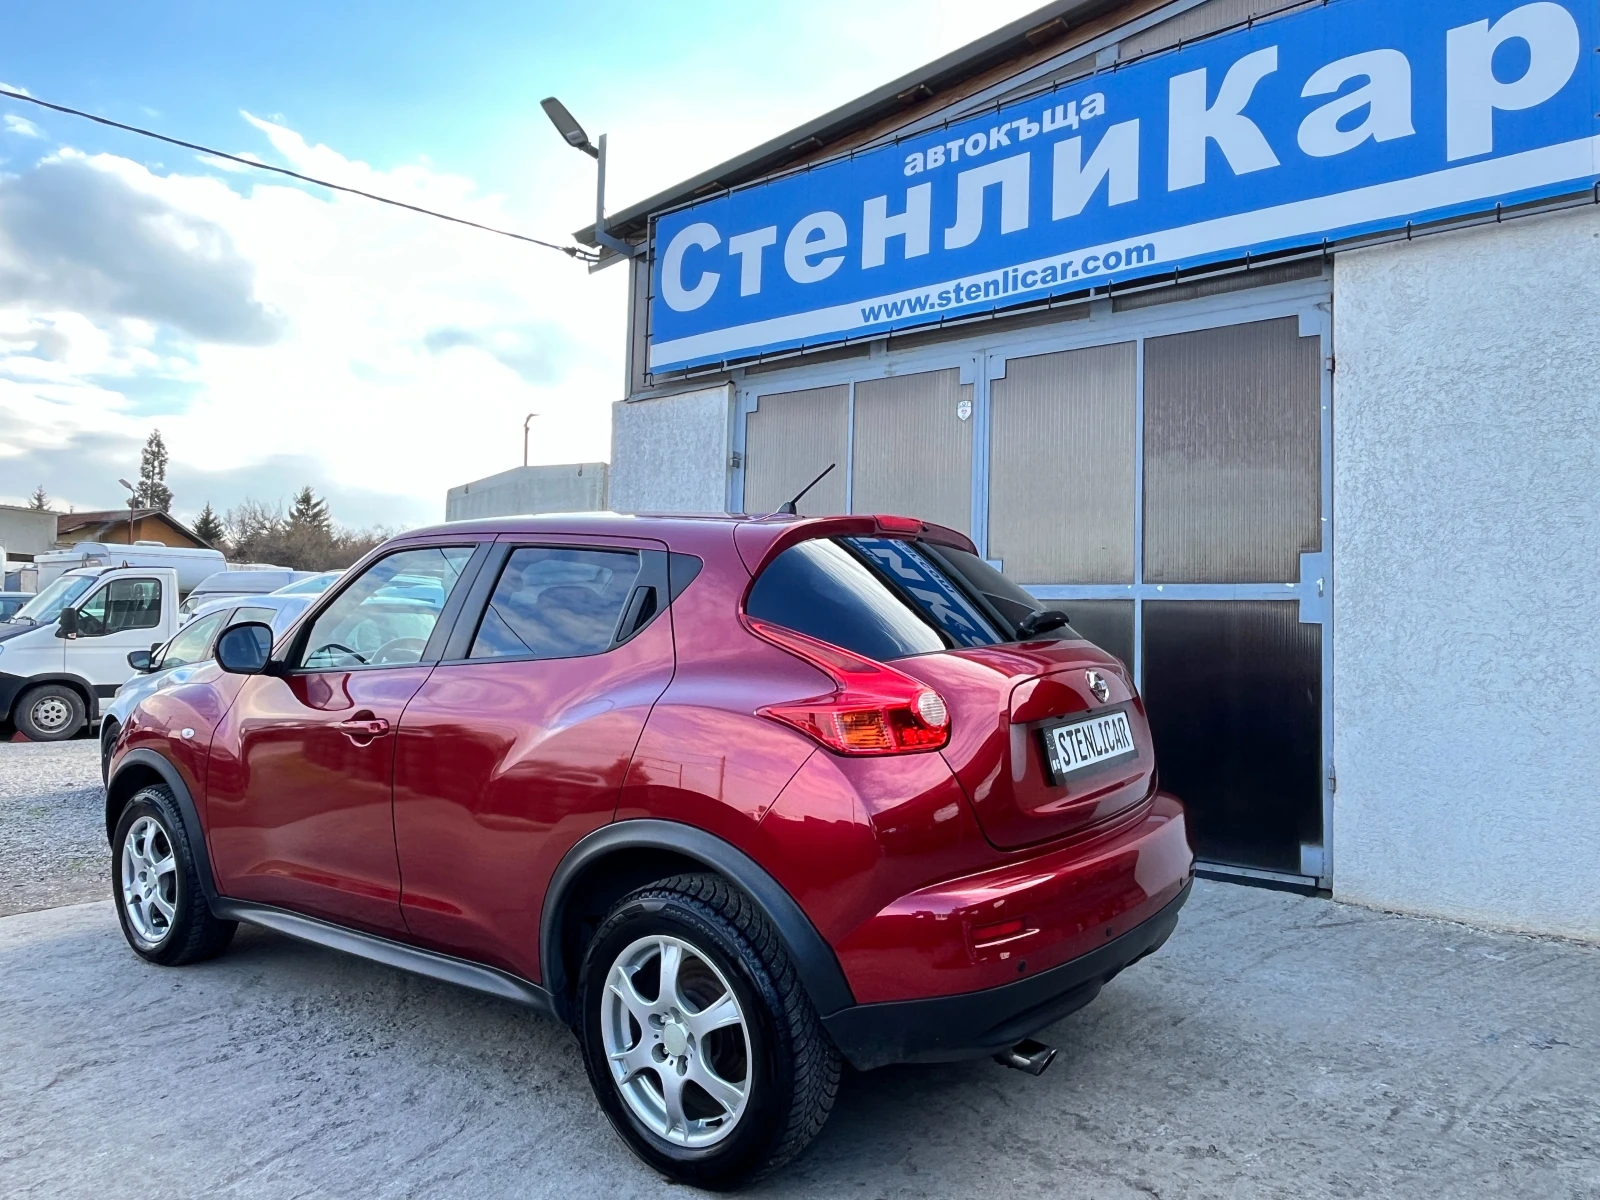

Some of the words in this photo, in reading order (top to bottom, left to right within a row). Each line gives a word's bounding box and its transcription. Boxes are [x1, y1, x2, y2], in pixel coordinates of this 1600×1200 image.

[662, 2, 1579, 311] СтенлиКар
[904, 92, 1105, 176] автокъща
[861, 243, 1155, 322] www.stenlicar.com
[1058, 717, 1130, 766] STENLICAR
